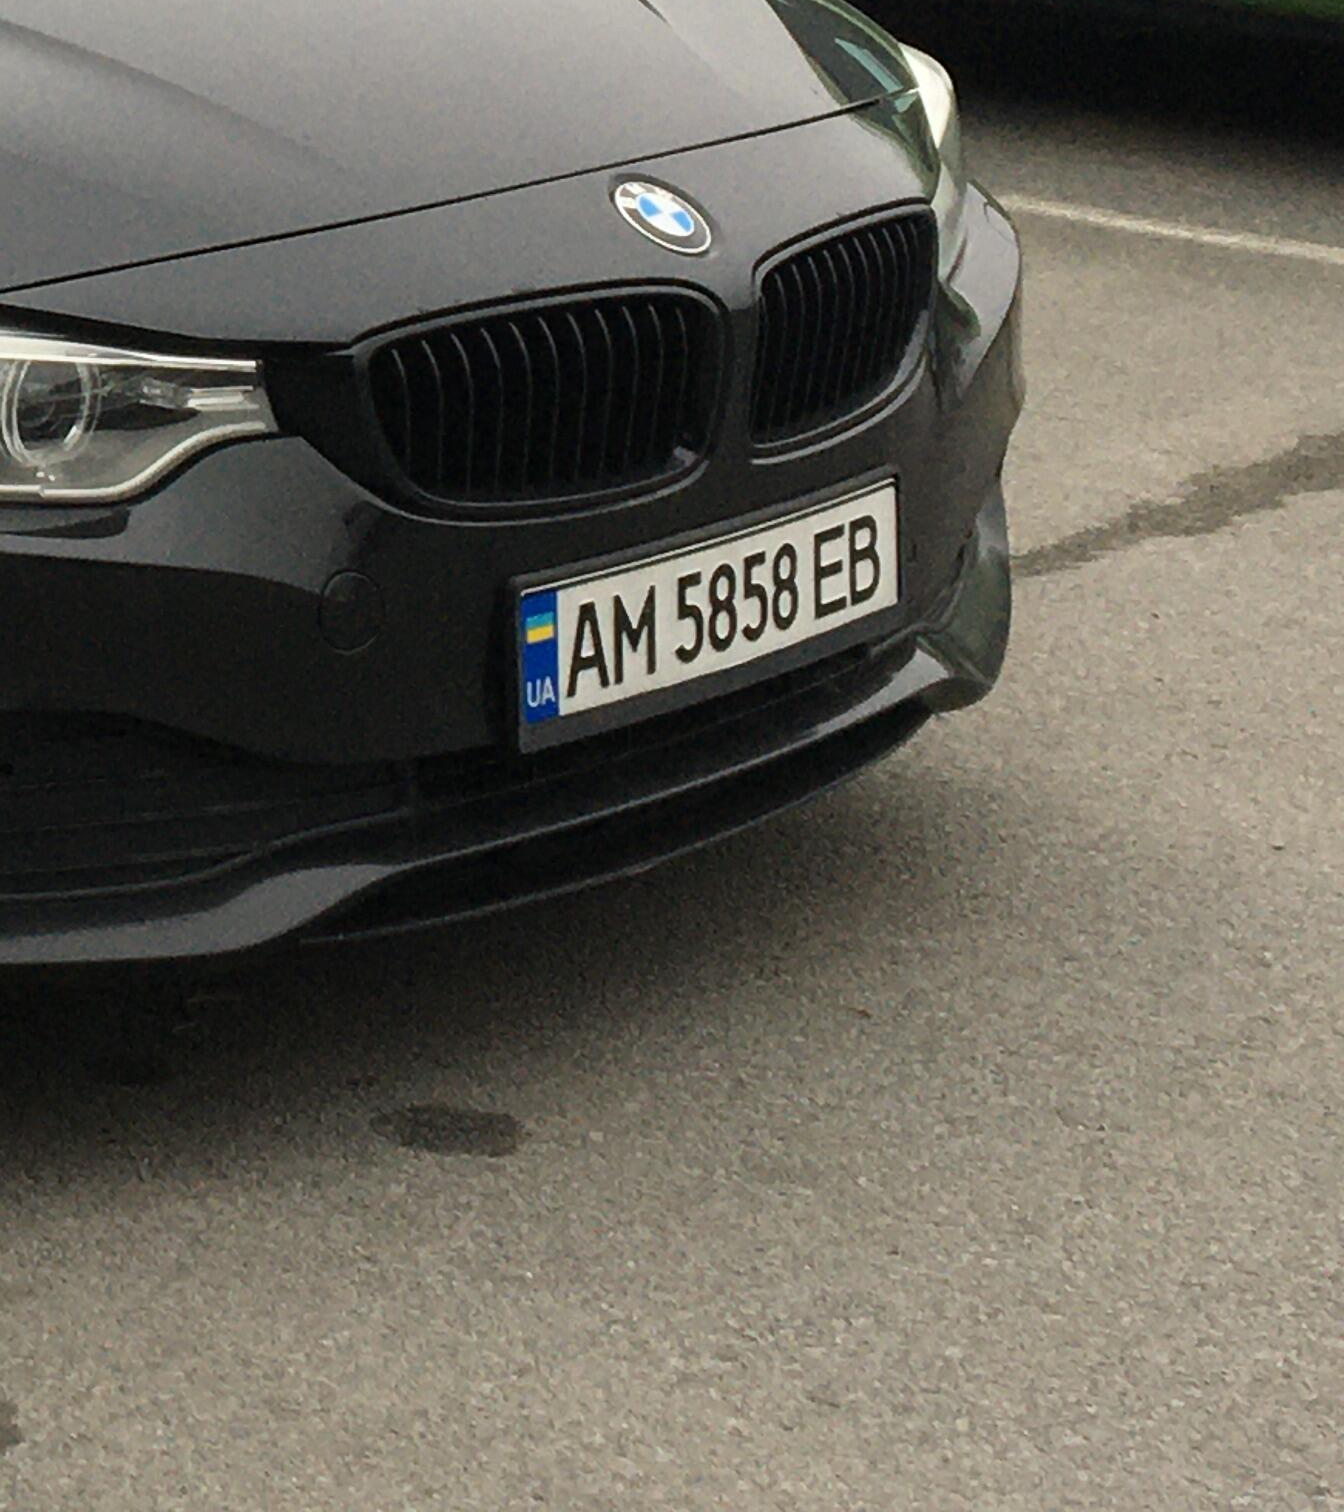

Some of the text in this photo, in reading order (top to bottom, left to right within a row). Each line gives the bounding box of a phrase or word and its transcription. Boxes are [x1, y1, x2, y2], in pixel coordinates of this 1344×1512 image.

[567, 514, 881, 698] AM 5858 EB
[526, 676, 557, 708] UA
